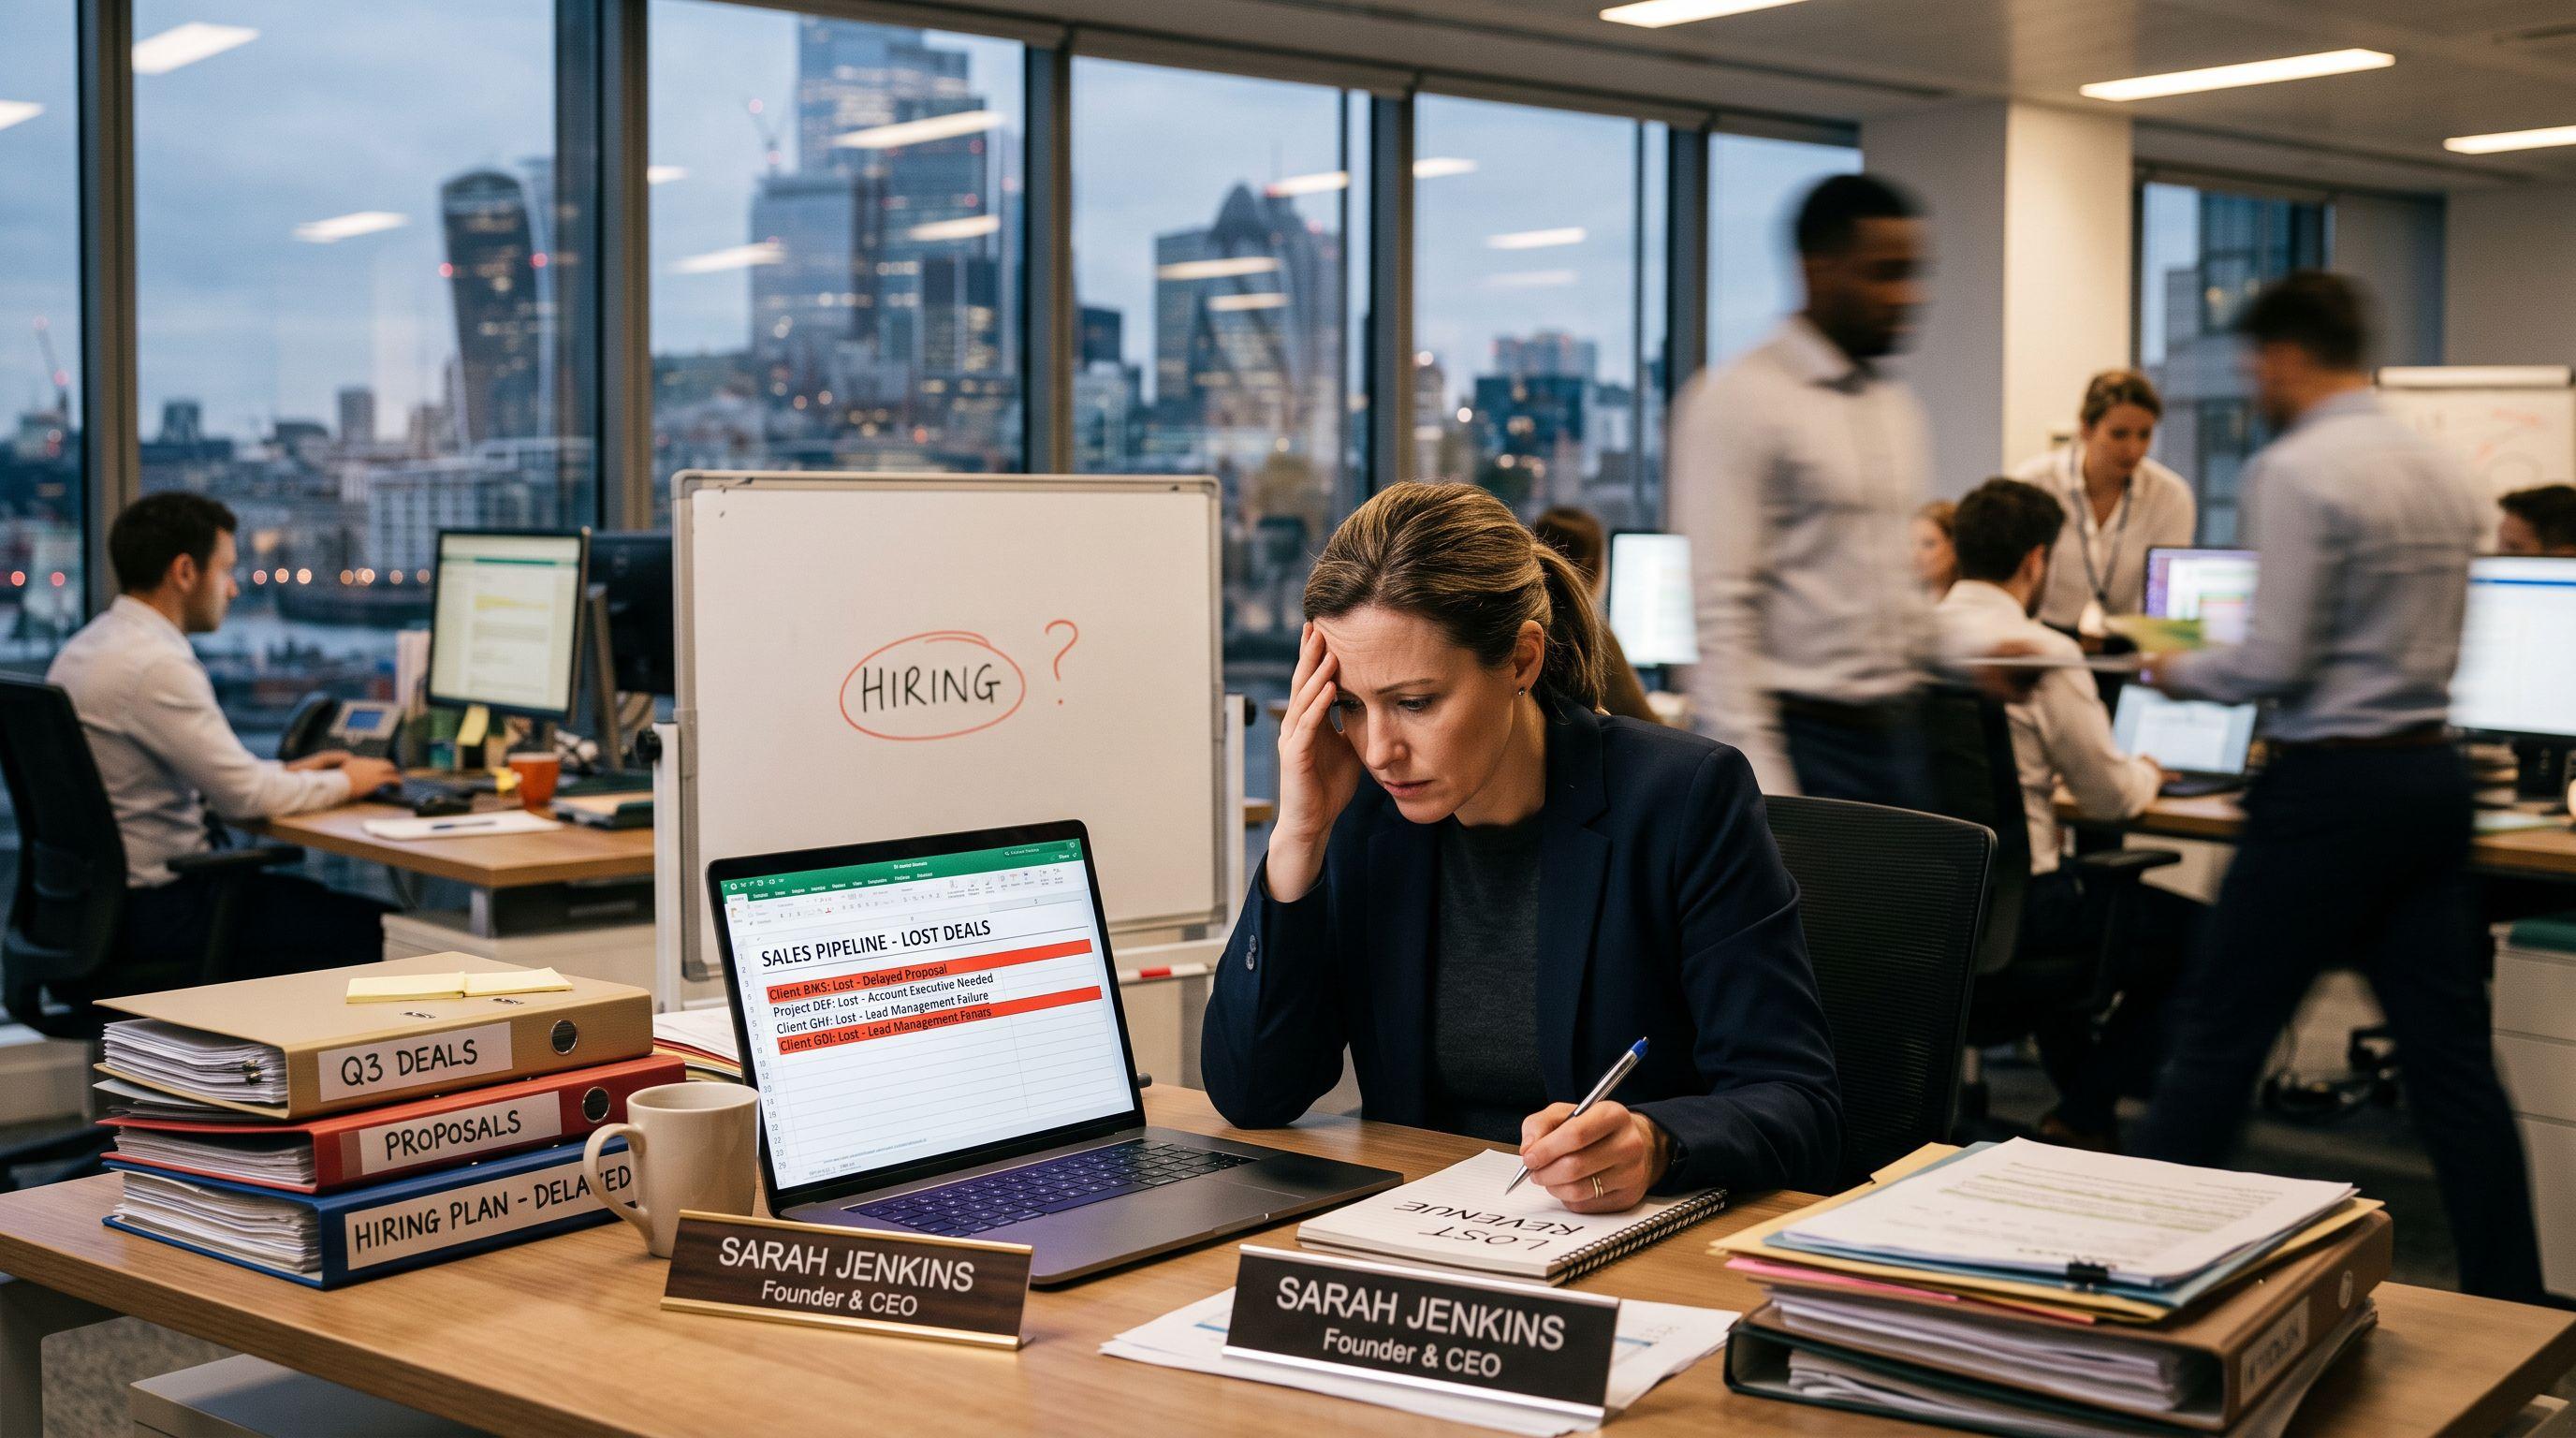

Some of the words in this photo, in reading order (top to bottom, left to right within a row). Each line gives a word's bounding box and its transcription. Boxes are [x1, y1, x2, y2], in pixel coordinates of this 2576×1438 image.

[862, 663, 1002, 712] HIRING
[1045, 619, 1079, 706] ?
[761, 945, 812, 967] SALES
[815, 934, 888, 960] PIPELINE
[901, 927, 939, 947] LOST
[944, 919, 991, 941] DEALS
[769, 986, 801, 1001] Client
[833, 978, 855, 990] Lost
[863, 971, 902, 987] Delayed
[905, 964, 947, 980] Proposal
[773, 1002, 812, 1018] Project
[813, 999, 836, 1012] DEF:
[838, 995, 859, 1007] Lost
[868, 988, 908, 1003] Account
[910, 981, 955, 996] Executive
[957, 973, 994, 988] Needed
[777, 1020, 808, 1034] Client
[835, 1012, 857, 1025] Lost
[865, 1006, 888, 1020] Lead
[891, 996, 958, 1016] Management
[958, 991, 989, 1004] Failure
[780, 1037, 812, 1051] Client
[839, 1030, 860, 1042] Lost
[868, 1023, 891, 1036] Lead
[894, 1013, 959, 1034] Management
[341, 1052, 383, 1088] Q3
[397, 1039, 479, 1074] DEALS
[385, 1109, 522, 1161] PROPOSALS
[354, 1209, 441, 1254] HIRING
[449, 1191, 509, 1230] PLAN
[534, 1165, 632, 1210] DELAED
[1394, 1200, 1585, 1237] REVENUE
[1418, 1225, 1550, 1251] LOST
[718, 1236, 828, 1277] SARAH
[835, 1249, 975, 1293] JENKINS
[761, 1280, 845, 1309] Founder
[847, 1289, 864, 1312] &
[870, 1291, 918, 1318] CEO
[1276, 1276, 1398, 1326] SARAH
[1406, 1297, 1566, 1352] JENKINS
[1323, 1328, 1418, 1364] Founder
[1421, 1343, 1439, 1369] &
[1444, 1346, 1502, 1379] CEO
